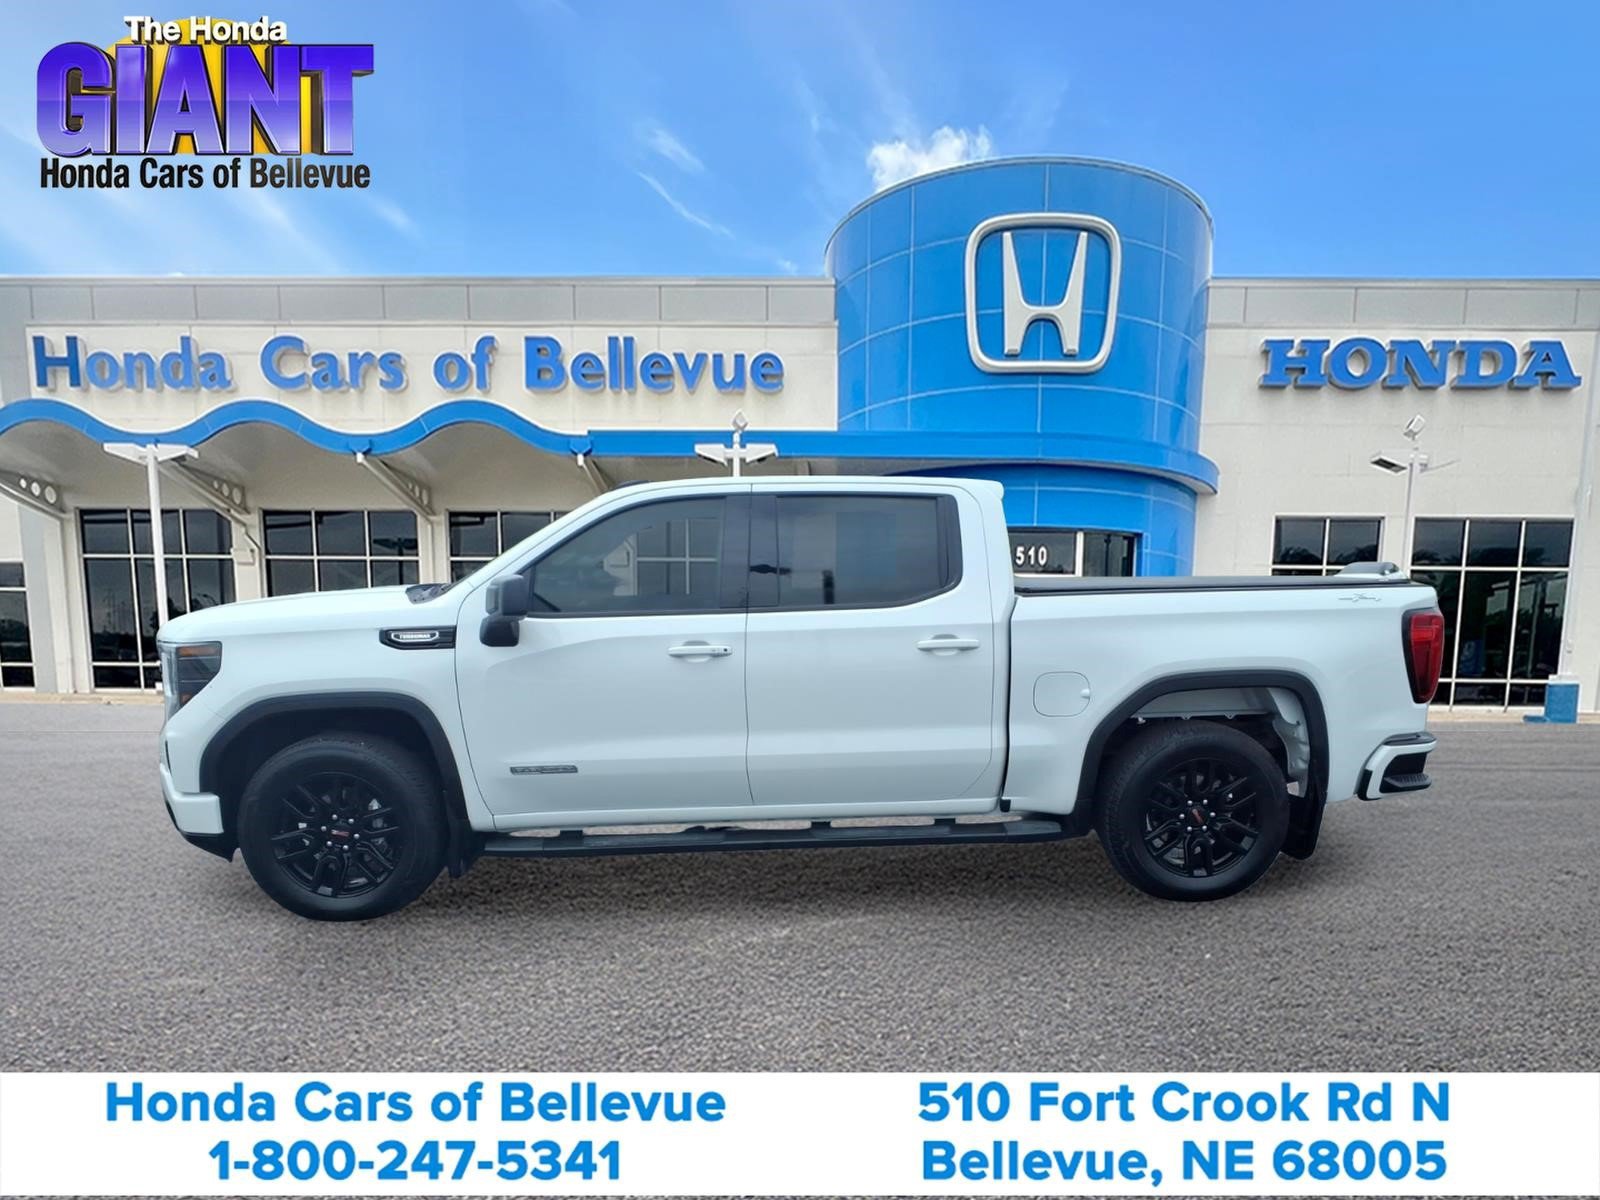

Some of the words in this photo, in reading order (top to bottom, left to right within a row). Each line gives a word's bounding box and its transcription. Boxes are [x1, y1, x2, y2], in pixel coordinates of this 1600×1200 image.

[33, 335, 232, 392] Honda
[261, 335, 406, 391] Cars
[433, 335, 497, 392] of
[524, 335, 784, 393] Bellevue
[1259, 336, 1582, 390] HONDA
[1015, 545, 1048, 566] 510
